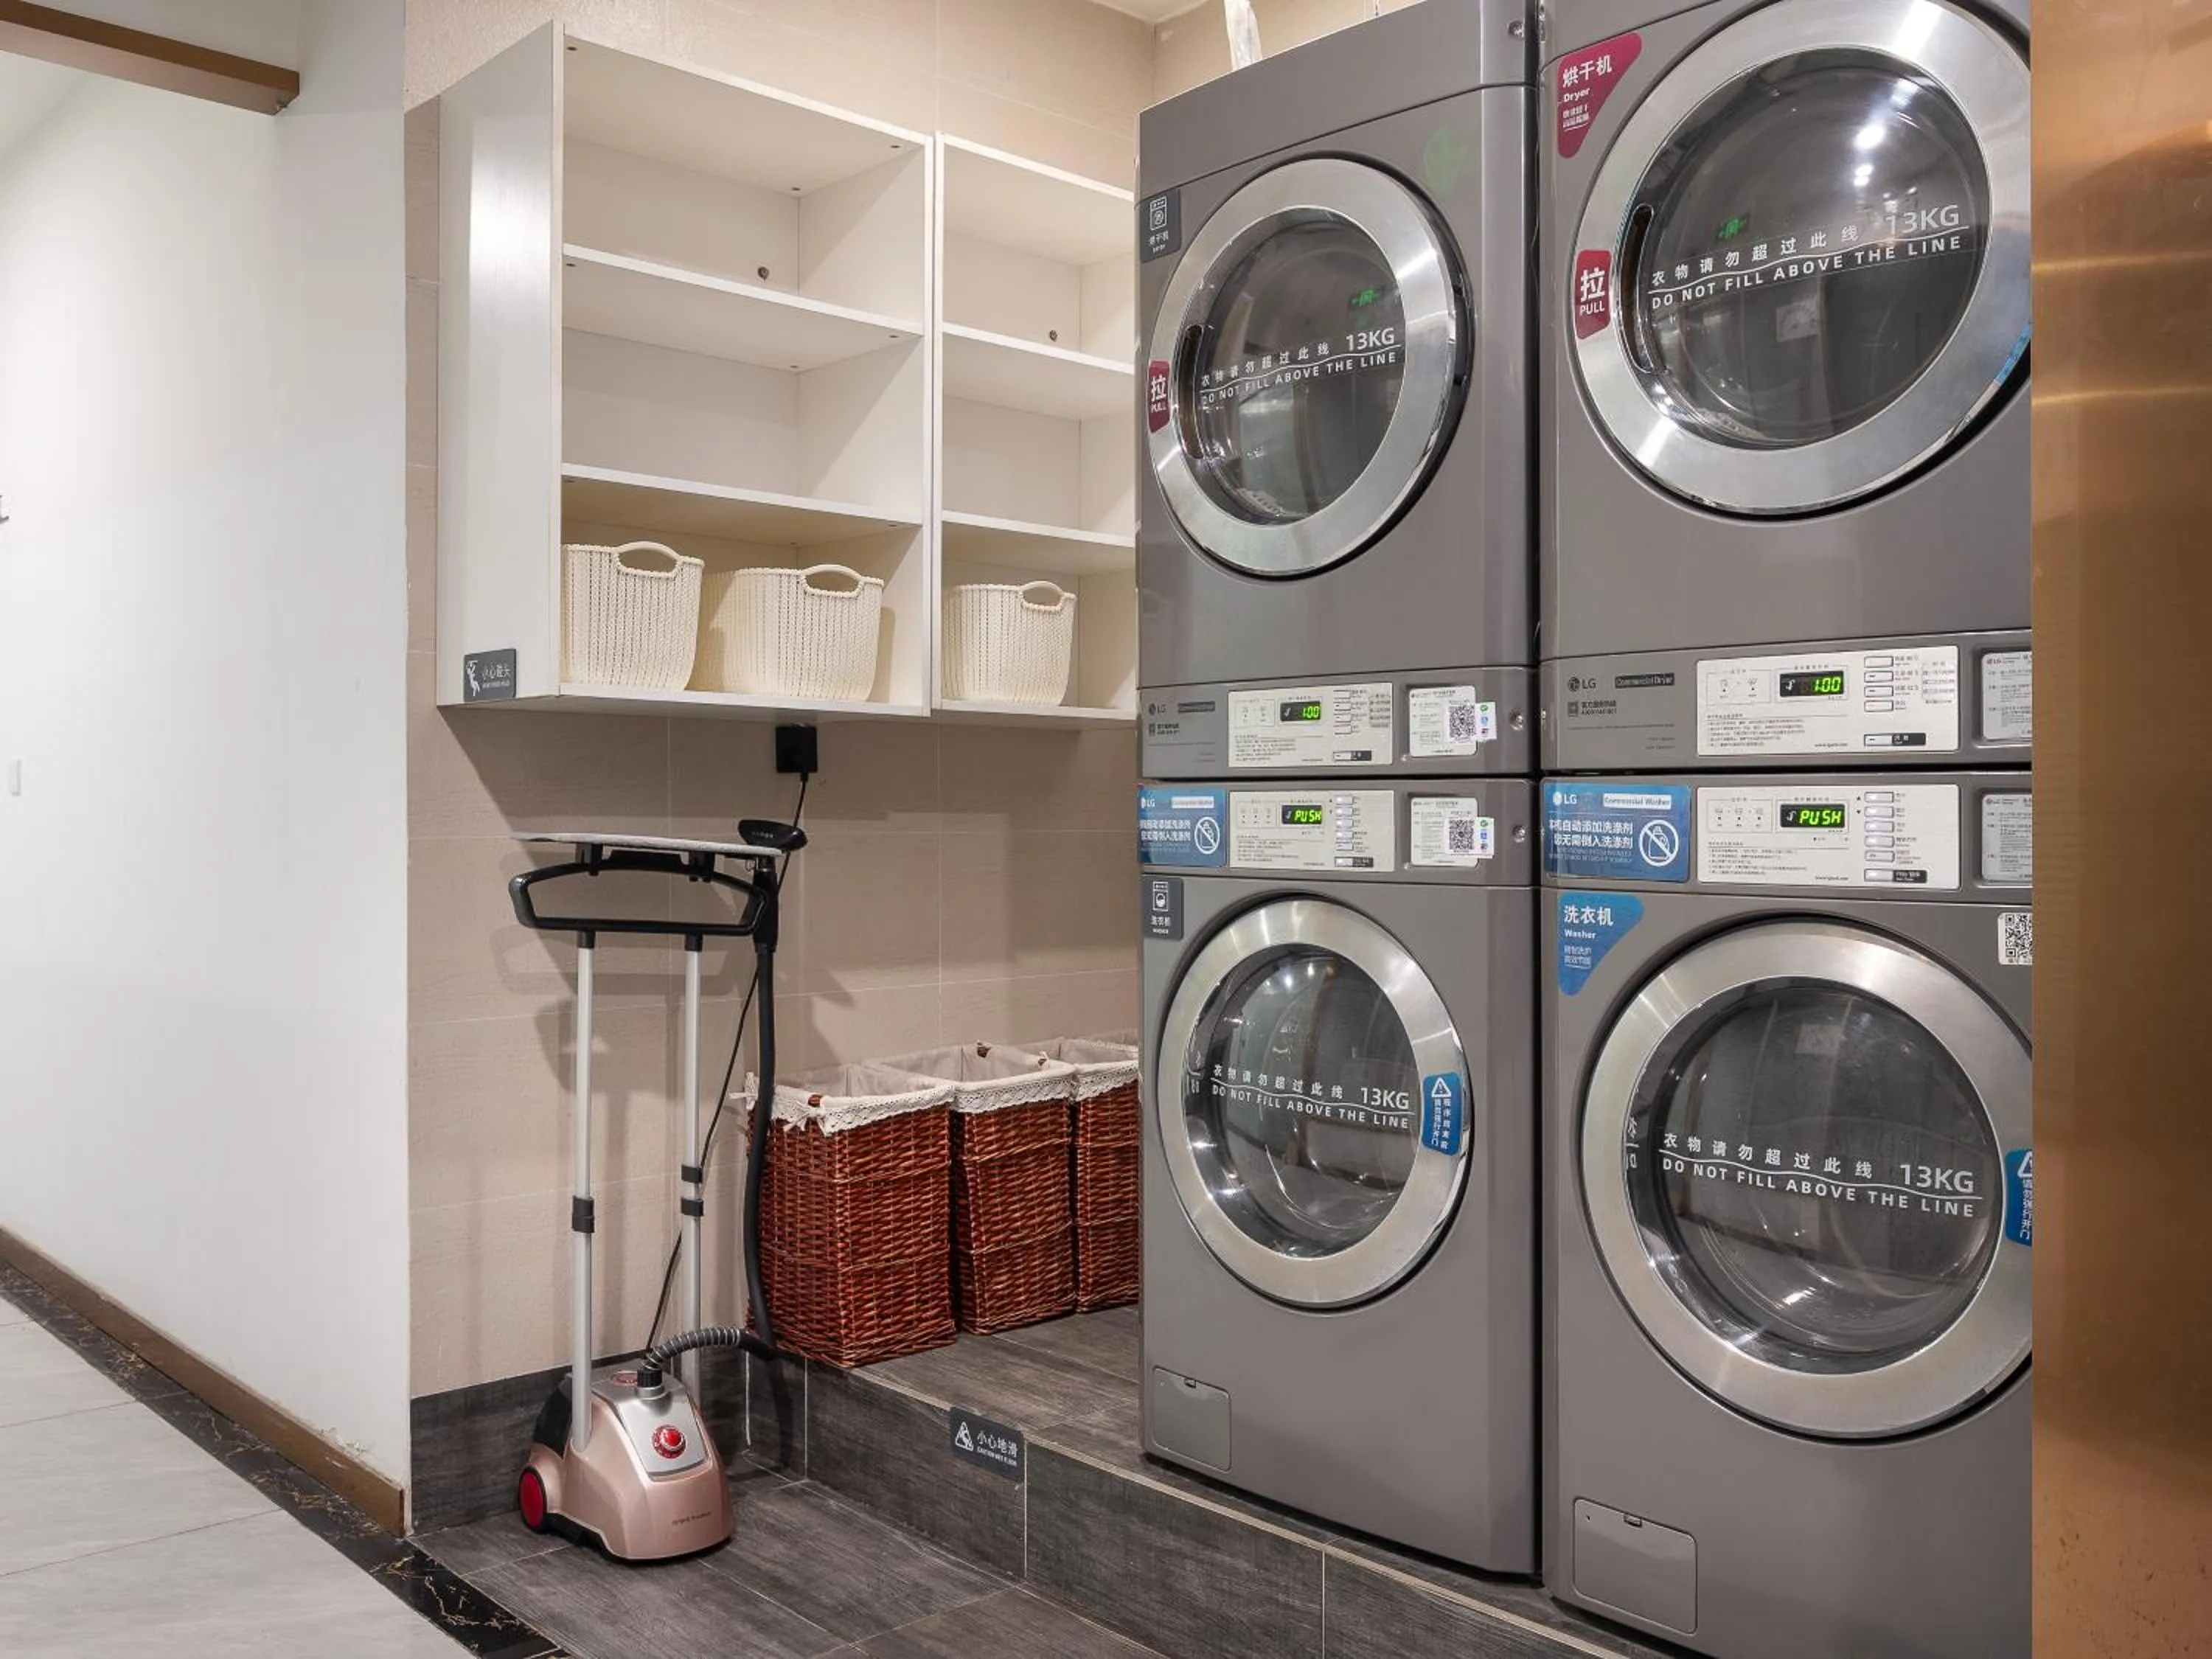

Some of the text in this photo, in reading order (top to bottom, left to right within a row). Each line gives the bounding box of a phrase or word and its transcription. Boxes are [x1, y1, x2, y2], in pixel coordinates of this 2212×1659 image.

[1563, 55, 1612, 88] 烘干机
[1564, 88, 1590, 102] Dryer
[1652, 204, 1959, 286] 衣物请勿超过此线 13KG
[1581, 267, 1604, 302] 拉
[1652, 236, 1961, 309] DO NOT FILL ABOVE THE LINE
[1580, 301, 1604, 316] PULL
[1346, 327, 1395, 351] 13KG
[1152, 374, 1166, 402] 拉
[1220, 386, 1239, 400] NOT
[1245, 378, 1269, 392] FILL
[1276, 366, 1319, 384] ABOVE
[1327, 359, 1353, 374] THE
[1360, 352, 1396, 367] LINE
[1582, 678, 1596, 689] LG
[1147, 799, 1155, 807] LG
[1564, 795, 1577, 804] LG
[1294, 810, 1322, 822] PUSH
[1799, 809, 1841, 825] PUSH
[1564, 904, 1614, 926] 洗衣机
[1564, 929, 1596, 939] Washer
[1212, 1085, 1408, 1129] DO NOT FILL ABOVE THE LINE
[1360, 1087, 1409, 1110] 13KG
[1663, 1133, 1974, 1193] 衣物请勿超过此线 13KG
[1663, 1158, 1974, 1217] DO NOT FILL ABOVE THE LINE
[977, 1430, 1018, 1458] 小心地滑
